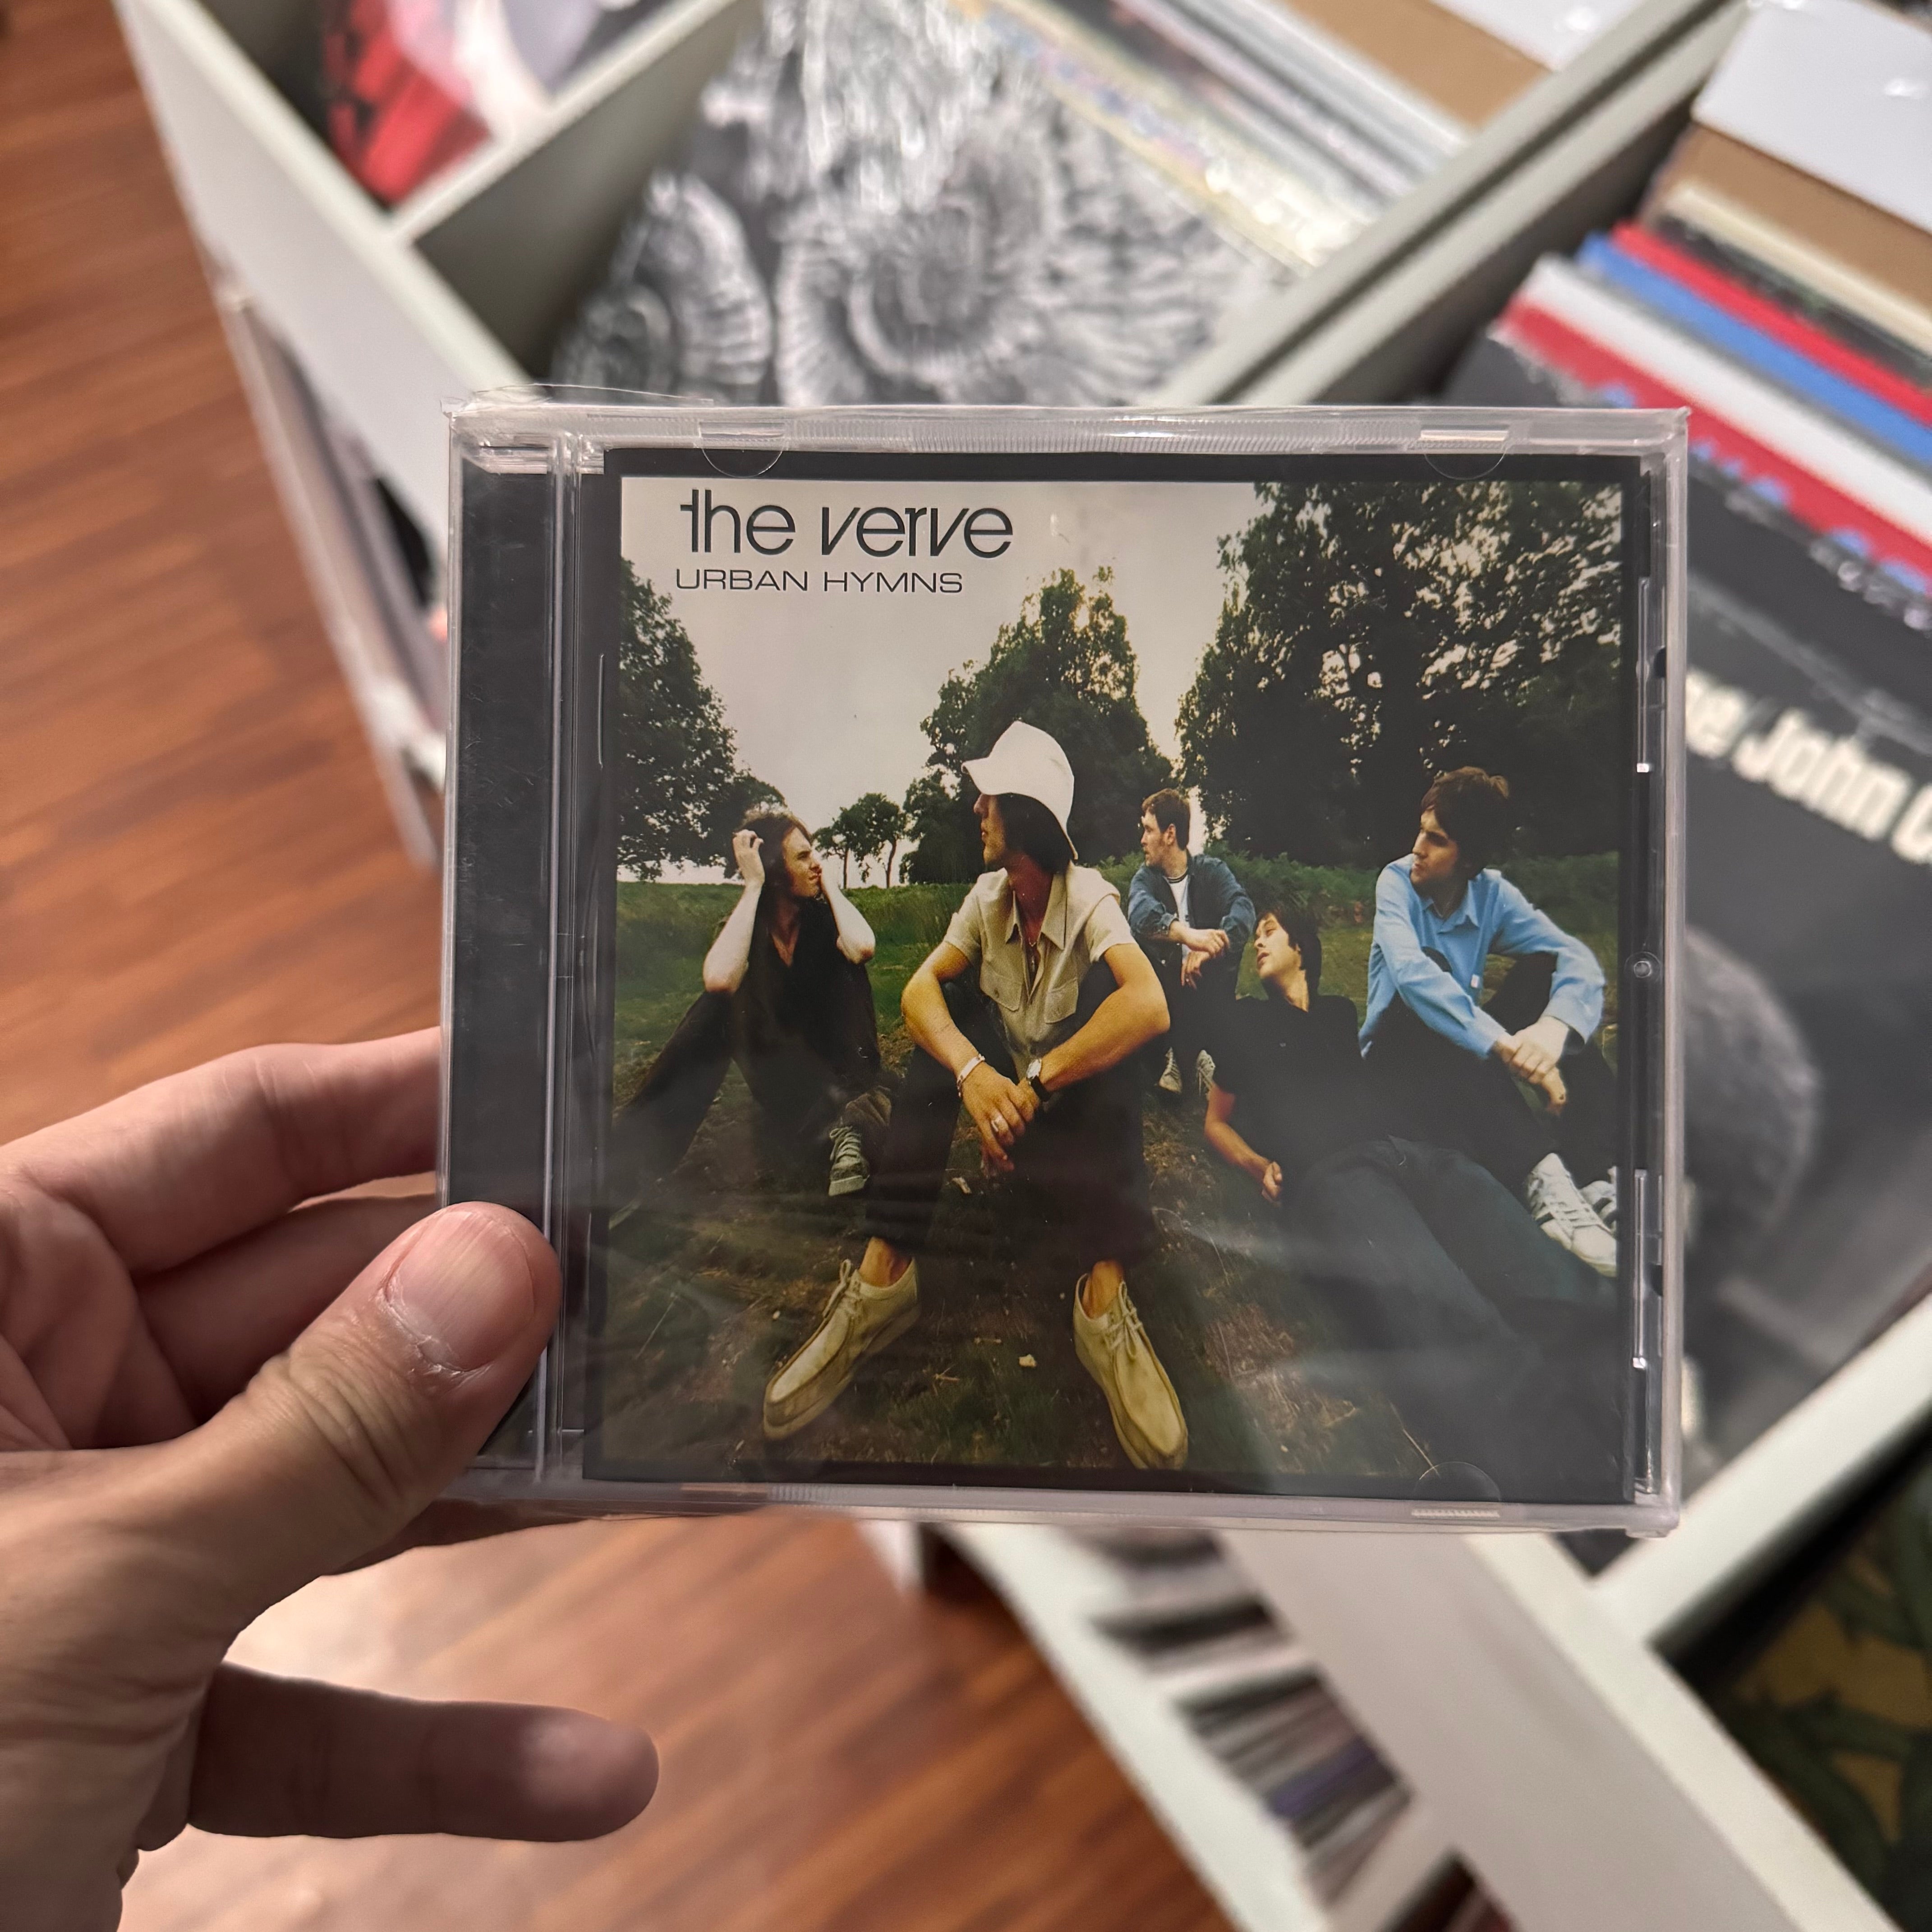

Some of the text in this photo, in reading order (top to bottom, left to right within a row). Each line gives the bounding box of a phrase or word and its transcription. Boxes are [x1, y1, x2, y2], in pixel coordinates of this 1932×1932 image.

[680, 488, 1013, 558] the verve
[676, 569, 962, 593] URBAN HYMNS
[1732, 708, 1911, 841] John
